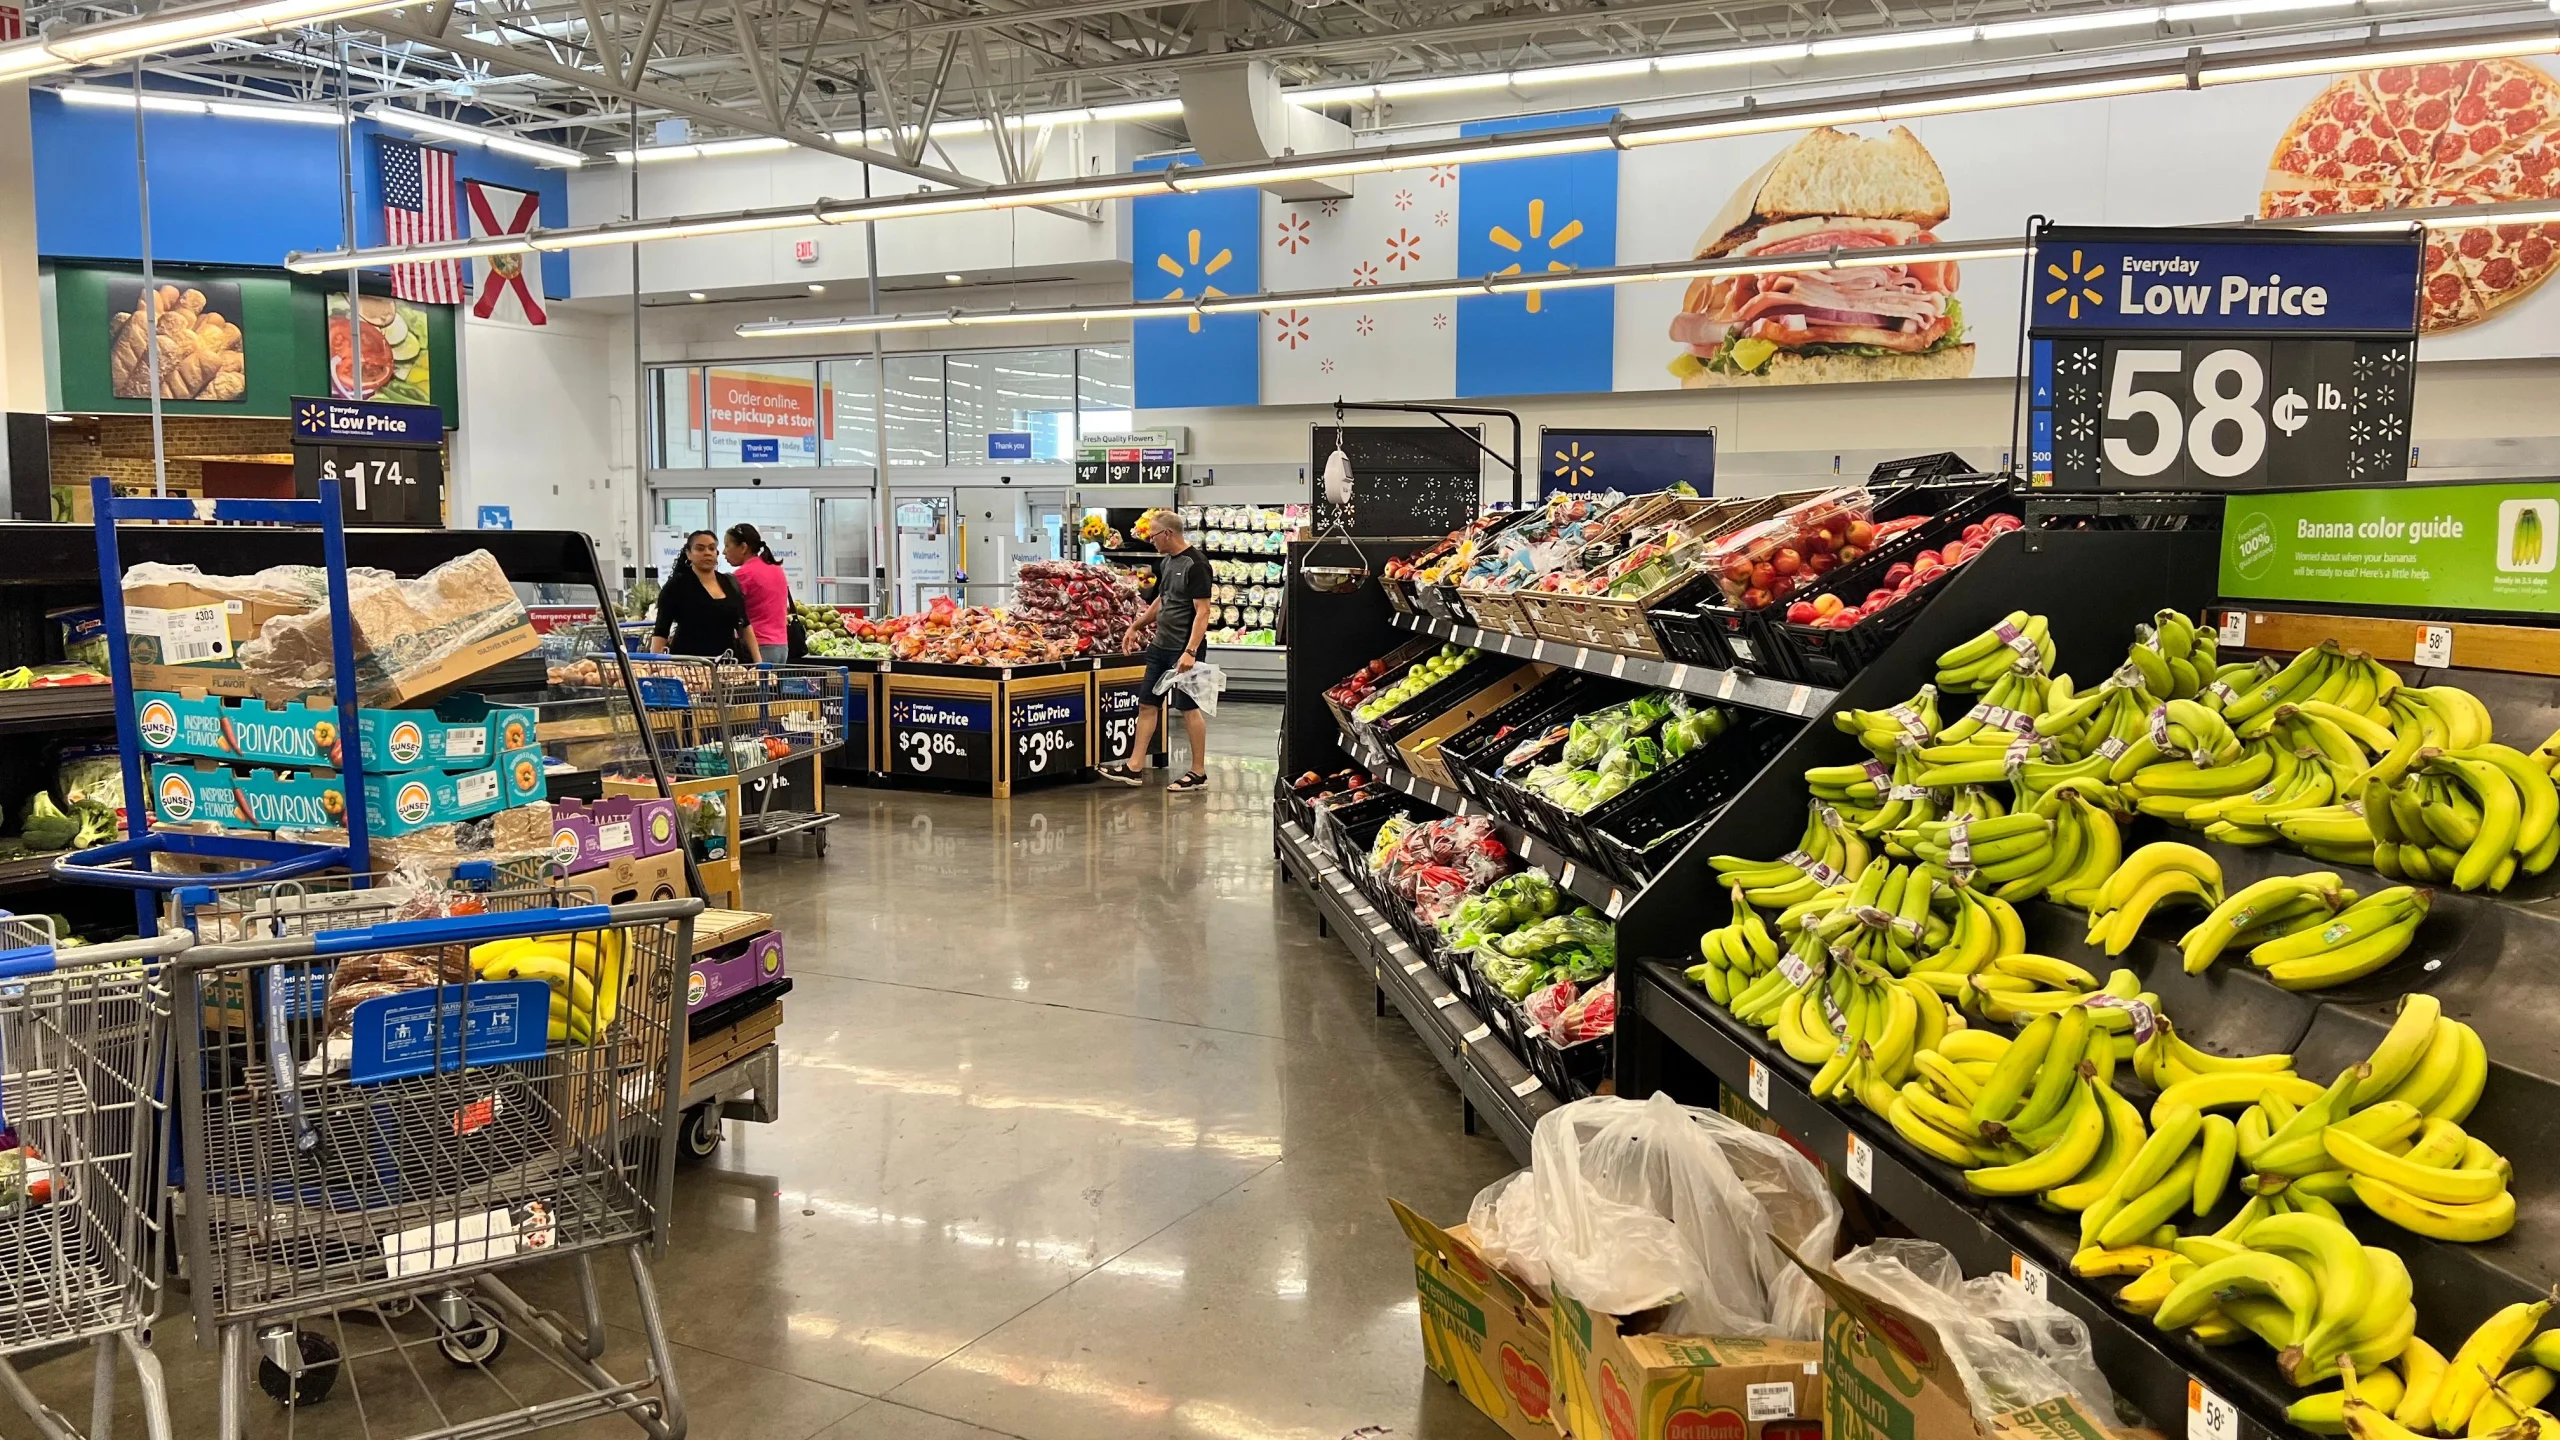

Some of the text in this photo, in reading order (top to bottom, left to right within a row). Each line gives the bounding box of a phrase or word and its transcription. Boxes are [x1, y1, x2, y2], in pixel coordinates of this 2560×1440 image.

[2122, 256, 2200, 277] Everyday
[2119, 274, 2328, 316] Low Price
[728, 389, 800, 410] Order online.
[2316, 382, 2347, 411] lb.
[329, 405, 359, 416] Everyday
[734, 408, 774, 428] pickup
[777, 412, 789, 425] at
[330, 413, 407, 432] Low Price
[712, 436, 724, 445] Get
[725, 437, 738, 446] the
[994, 442, 1013, 450] Thank
[1083, 434, 1154, 444] Fresh Quality Flowers
[747, 444, 774, 453] Thank you
[2032, 451, 2051, 462] 500
[2297, 516, 2463, 544] Banana color guide
[2239, 531, 2270, 557] 100%
[912, 551, 940, 560] Walmart+
[2295, 552, 2417, 564] Worried about when your bananas
[2293, 566, 2430, 581] will be ready to eat? Here's a little help.
[2532, 577, 2548, 587] days
[195, 610, 214, 621] 4303
[530, 612, 571, 623] Emergency
[212, 680, 246, 688] FLAVOR
[1114, 697, 1130, 708] Low
[912, 709, 969, 726] Low Price
[1027, 705, 1070, 723] Low Price
[141, 722, 176, 734] SUNSET
[184, 715, 221, 732] INSPIRED
[186, 732, 219, 748] FLAVOR
[237, 722, 316, 757] POIVRONS
[391, 742, 420, 752] SUNSET
[162, 796, 193, 808] SUNSET
[200, 787, 235, 804] INSPIRED
[205, 803, 235, 818] FLAVOR
[250, 793, 327, 825] POIVRONS
[399, 802, 430, 816] SUNSET
[278, 1052, 295, 1088] Walmart
[1418, 1272, 1470, 1322] Premium
[1421, 1294, 1482, 1354] BANANAS
[2206, 1400, 2225, 1432] 58¢
[1671, 1424, 1741, 1440] Del Monte
